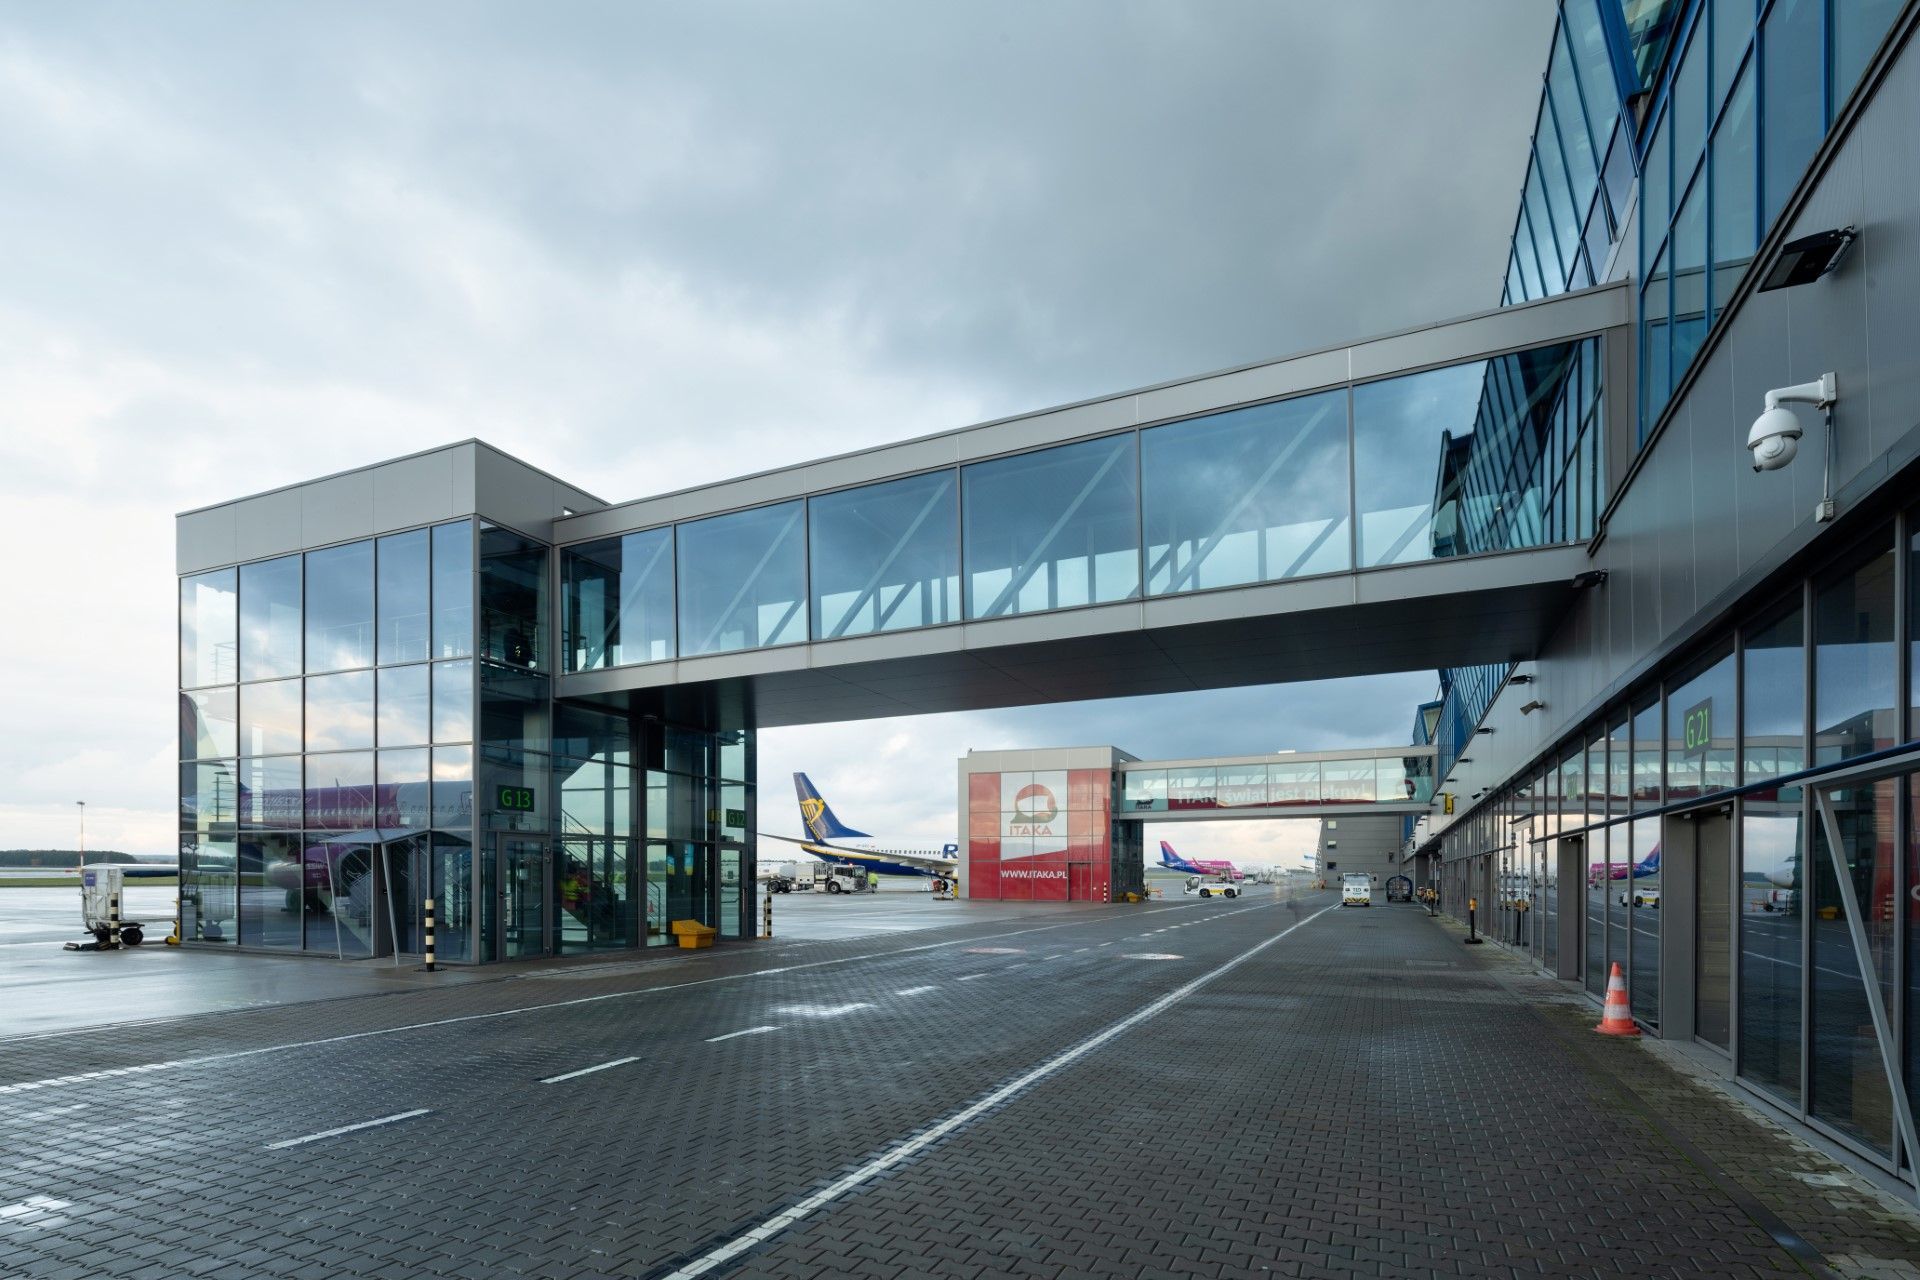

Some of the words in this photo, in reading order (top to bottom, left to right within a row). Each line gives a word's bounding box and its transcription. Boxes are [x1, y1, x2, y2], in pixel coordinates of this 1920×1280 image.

[1687, 715, 1694, 750] G
[1697, 708, 1709, 746] 21
[502, 789, 512, 807] G
[515, 790, 531, 808] 13
[1224, 786, 1266, 803] świat
[1270, 786, 1302, 804] jest
[1009, 824, 1053, 836] ITAKA
[1001, 870, 1068, 879] WWW.ITAKA.PL
